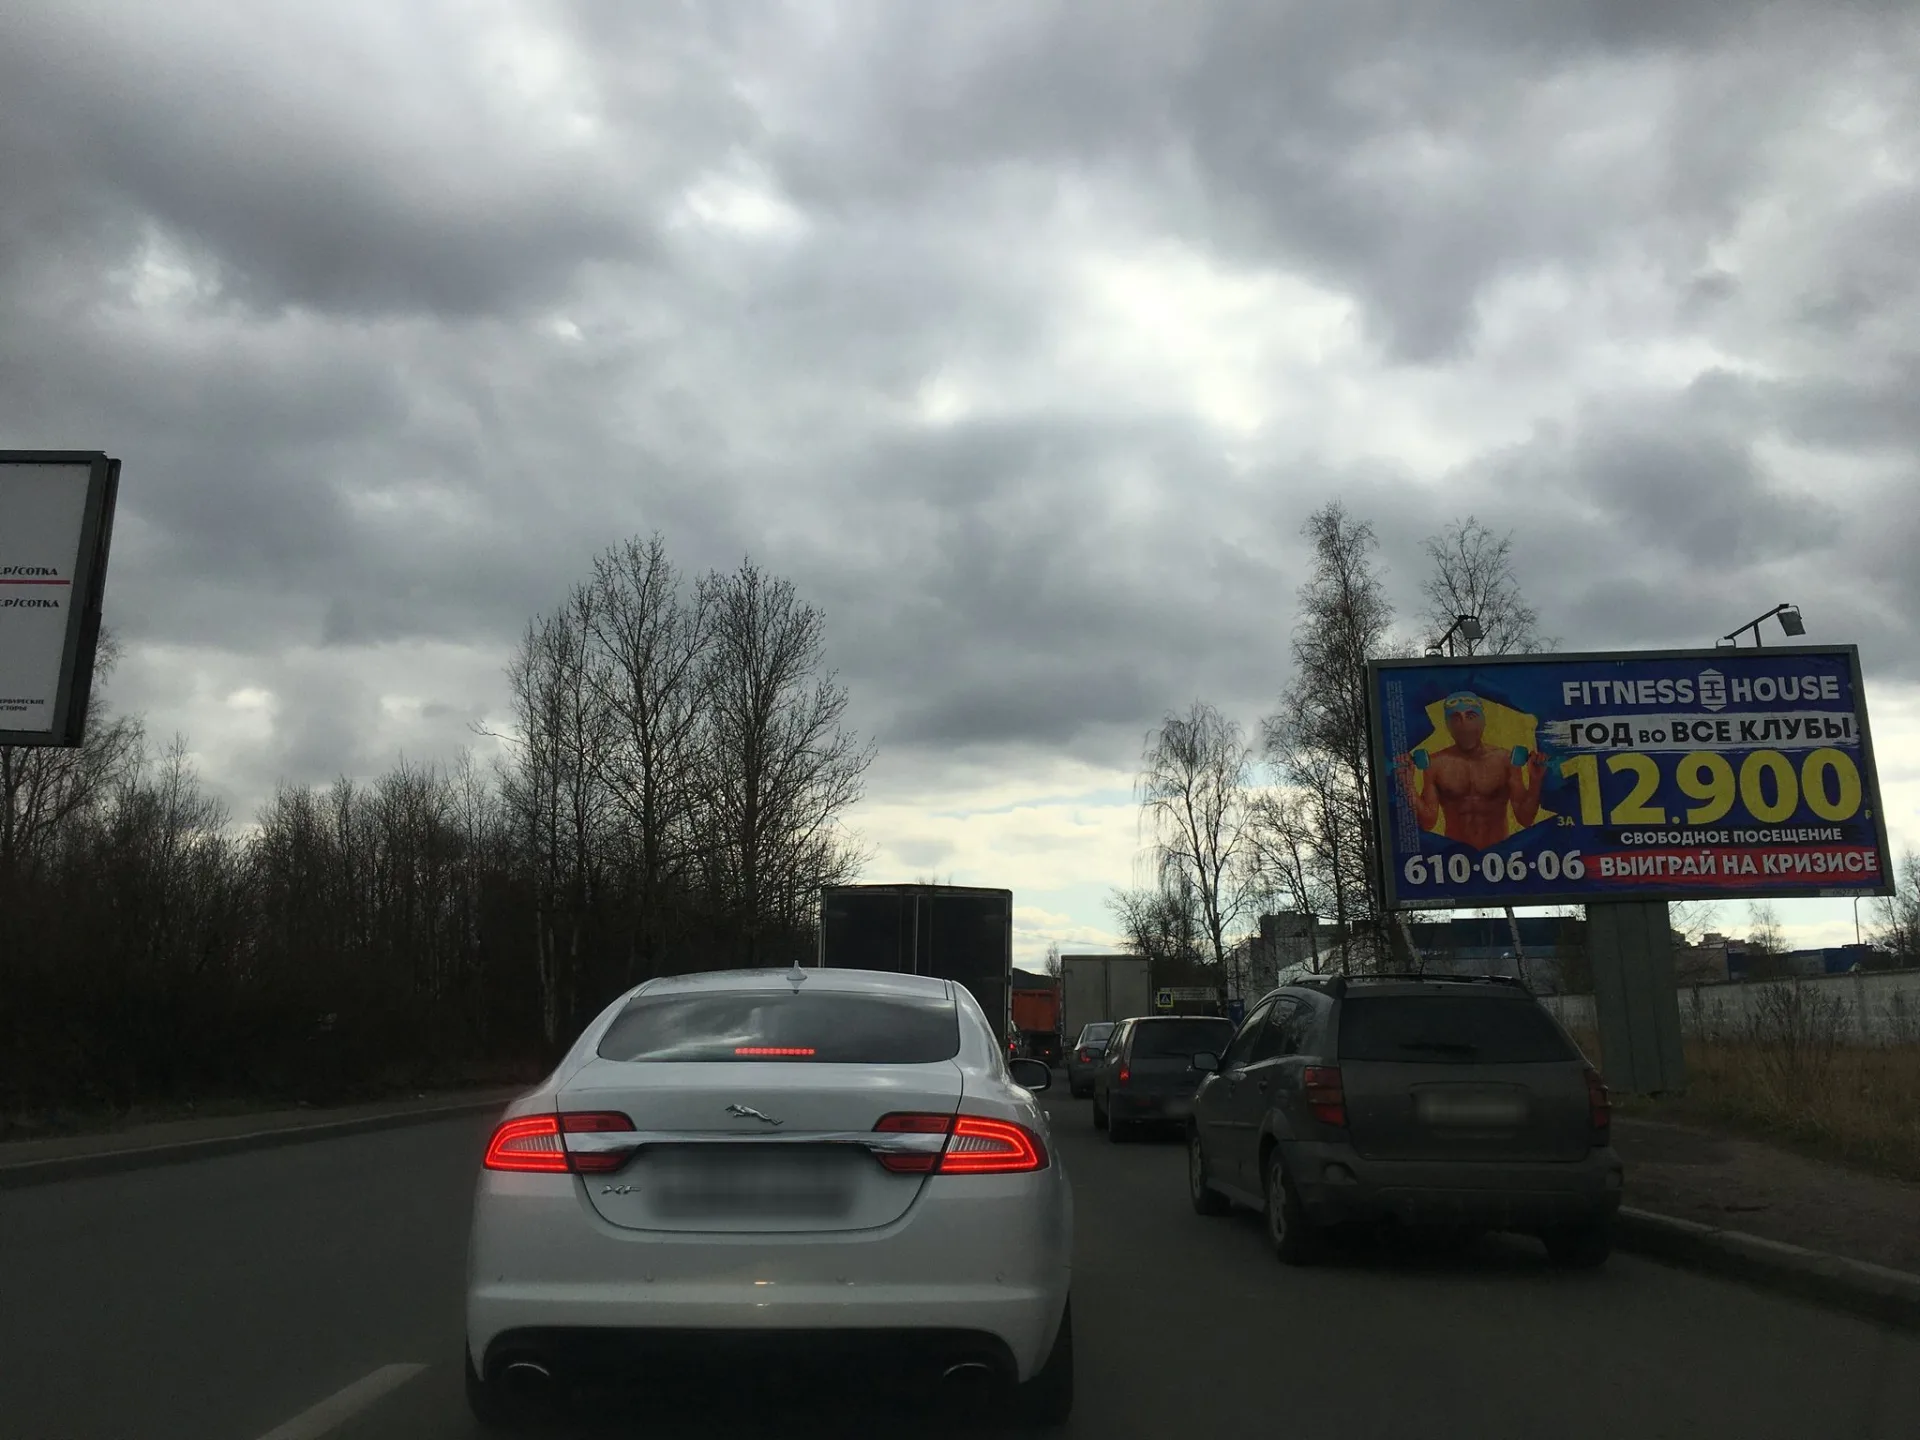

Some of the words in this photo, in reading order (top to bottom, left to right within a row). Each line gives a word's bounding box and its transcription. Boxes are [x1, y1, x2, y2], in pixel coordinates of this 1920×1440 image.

[0, 567, 58, 576] .Р/СОТКА
[0, 598, 60, 608] .Р/СОТКА
[1563, 679, 1695, 705] FITNESS
[1731, 676, 1840, 702] HOUSE
[1570, 722, 1634, 747] ГОД
[1671, 720, 1732, 743] ВСЕ
[1740, 717, 1851, 741] КЛУБЫ
[1561, 749, 1860, 826] 12.900
[1620, 831, 1729, 846] СВОБОДНОЕ
[1733, 828, 1842, 843] ПОСЕЩЕНИЕ
[1600, 850, 1717, 877] ВЫИГРАЙ
[1723, 853, 1758, 875] НА
[1762, 851, 1878, 875] КРИЗИСЕ
